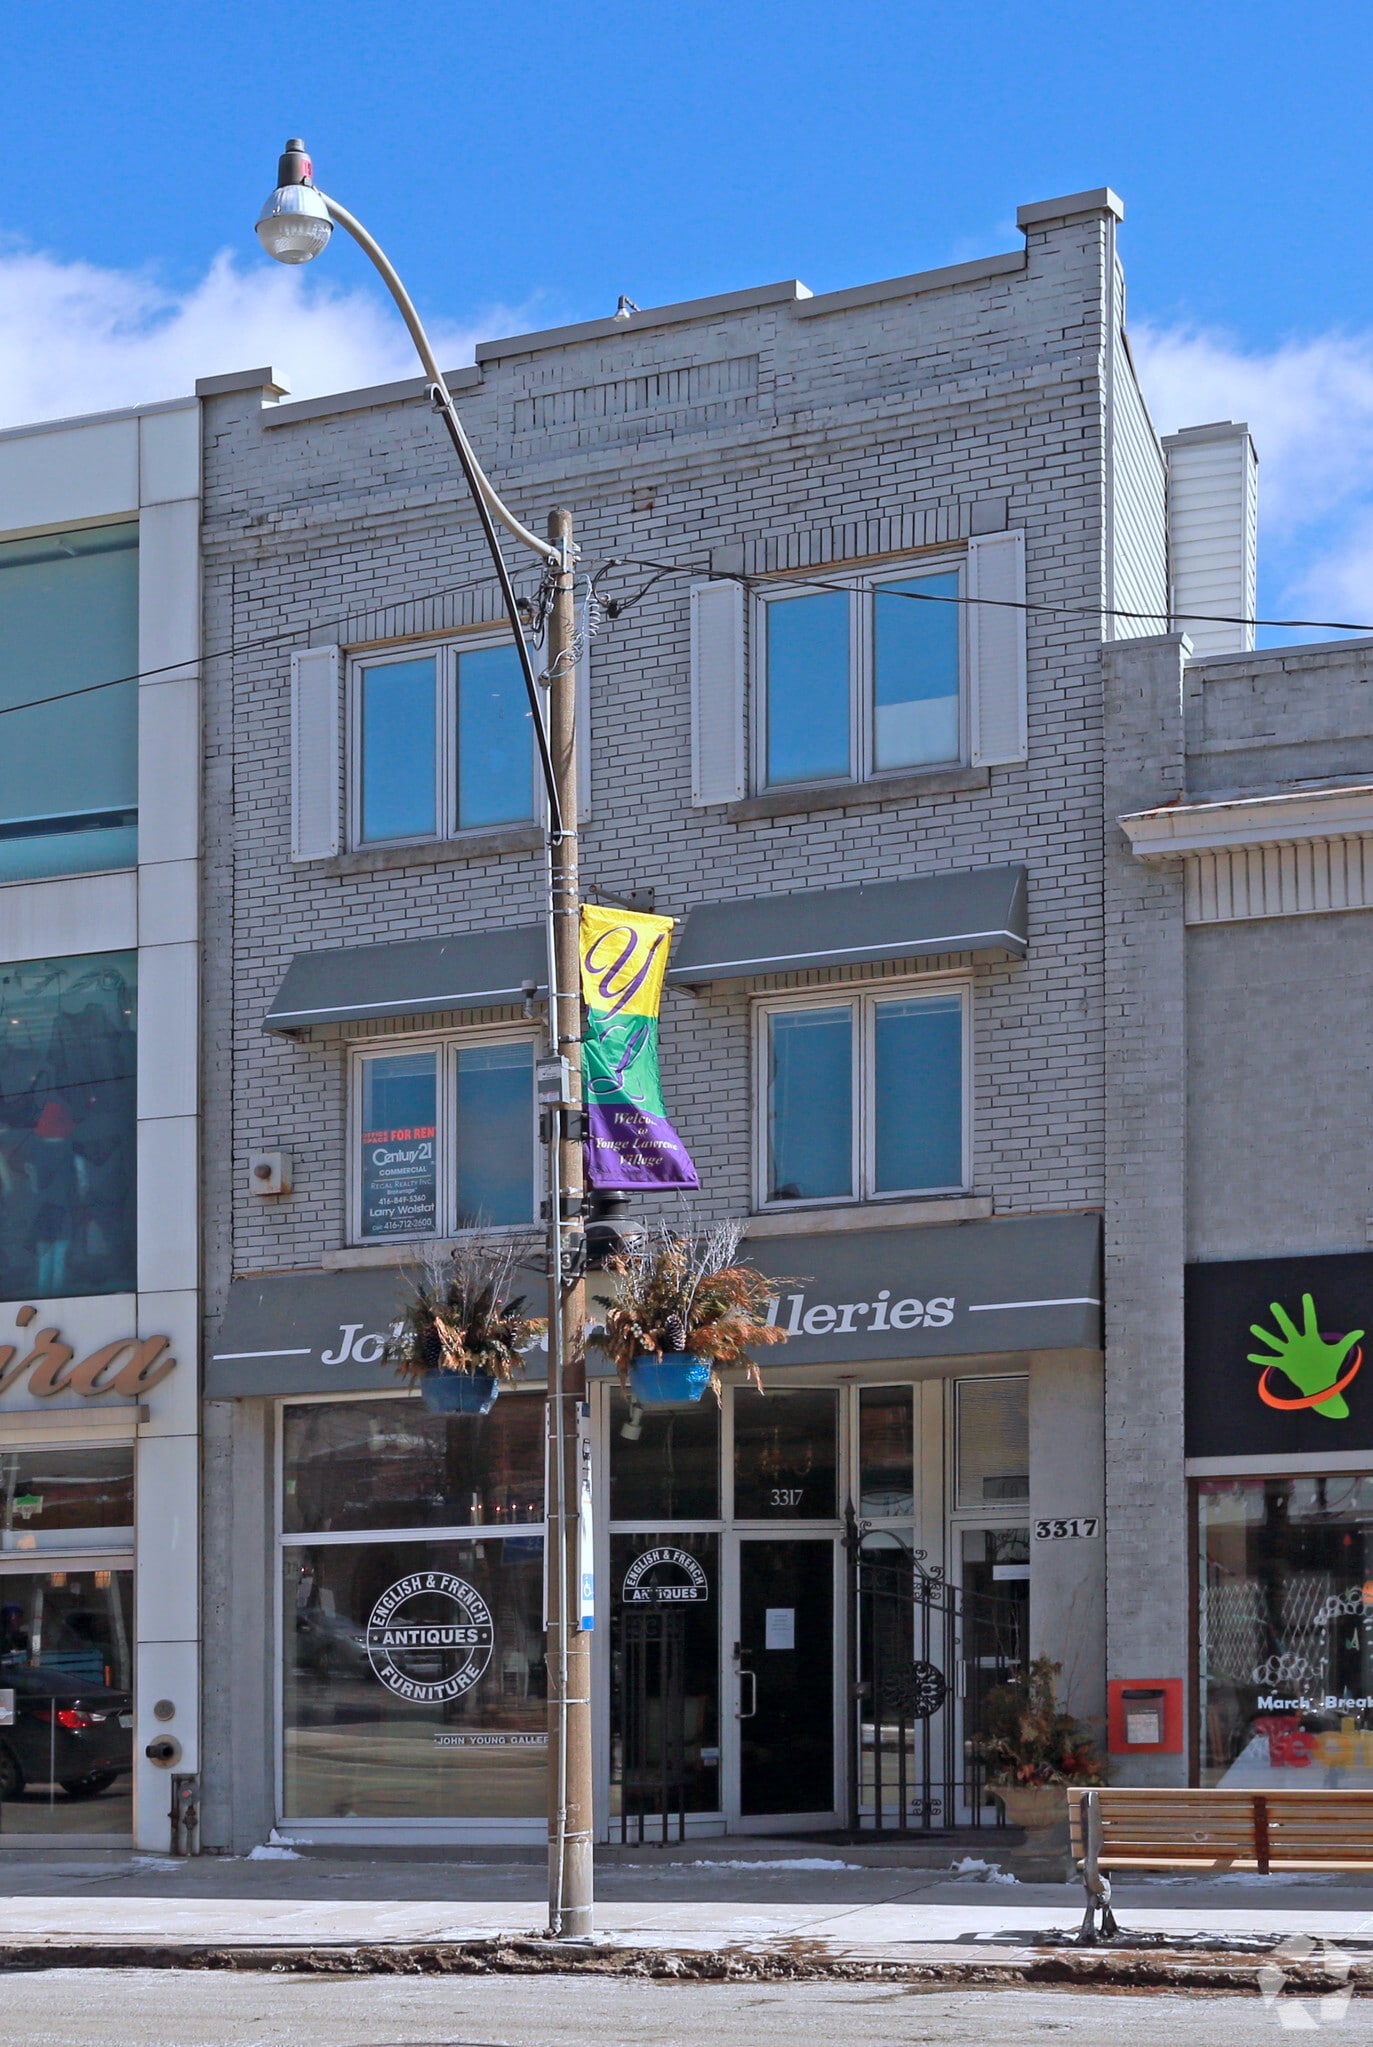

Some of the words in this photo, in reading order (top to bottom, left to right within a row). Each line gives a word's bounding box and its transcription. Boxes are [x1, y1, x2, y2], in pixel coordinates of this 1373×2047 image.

[613, 1112, 658, 1126] Welco
[391, 1129, 411, 1141] FOR
[413, 1127, 436, 1139] REN
[595, 1138, 629, 1152] Yonge
[620, 1153, 663, 1167] Village
[379, 1166, 427, 1176] COMMERCIAL
[370, 1208, 395, 1218] Larry
[397, 1203, 435, 1214] Wolstat
[764, 1289, 956, 1337] lleries
[770, 1489, 804, 1506] 3317
[1036, 1519, 1098, 1539] 3317
[627, 1551, 660, 1586] ENGLISH
[663, 1550, 670, 1560] &
[673, 1552, 704, 1585] FRENCH
[373, 1576, 422, 1627] ENGLISH
[427, 1574, 436, 1588] &
[440, 1576, 488, 1624] FRENCH
[632, 1588, 698, 1599] ANIQUES
[383, 1628, 479, 1645] ANTIQUES
[380, 1663, 480, 1699] FURNITURE
[1257, 1696, 1310, 1710] March
[438, 1736, 465, 1745] JOHN
[470, 1736, 506, 1745] YOUNG
